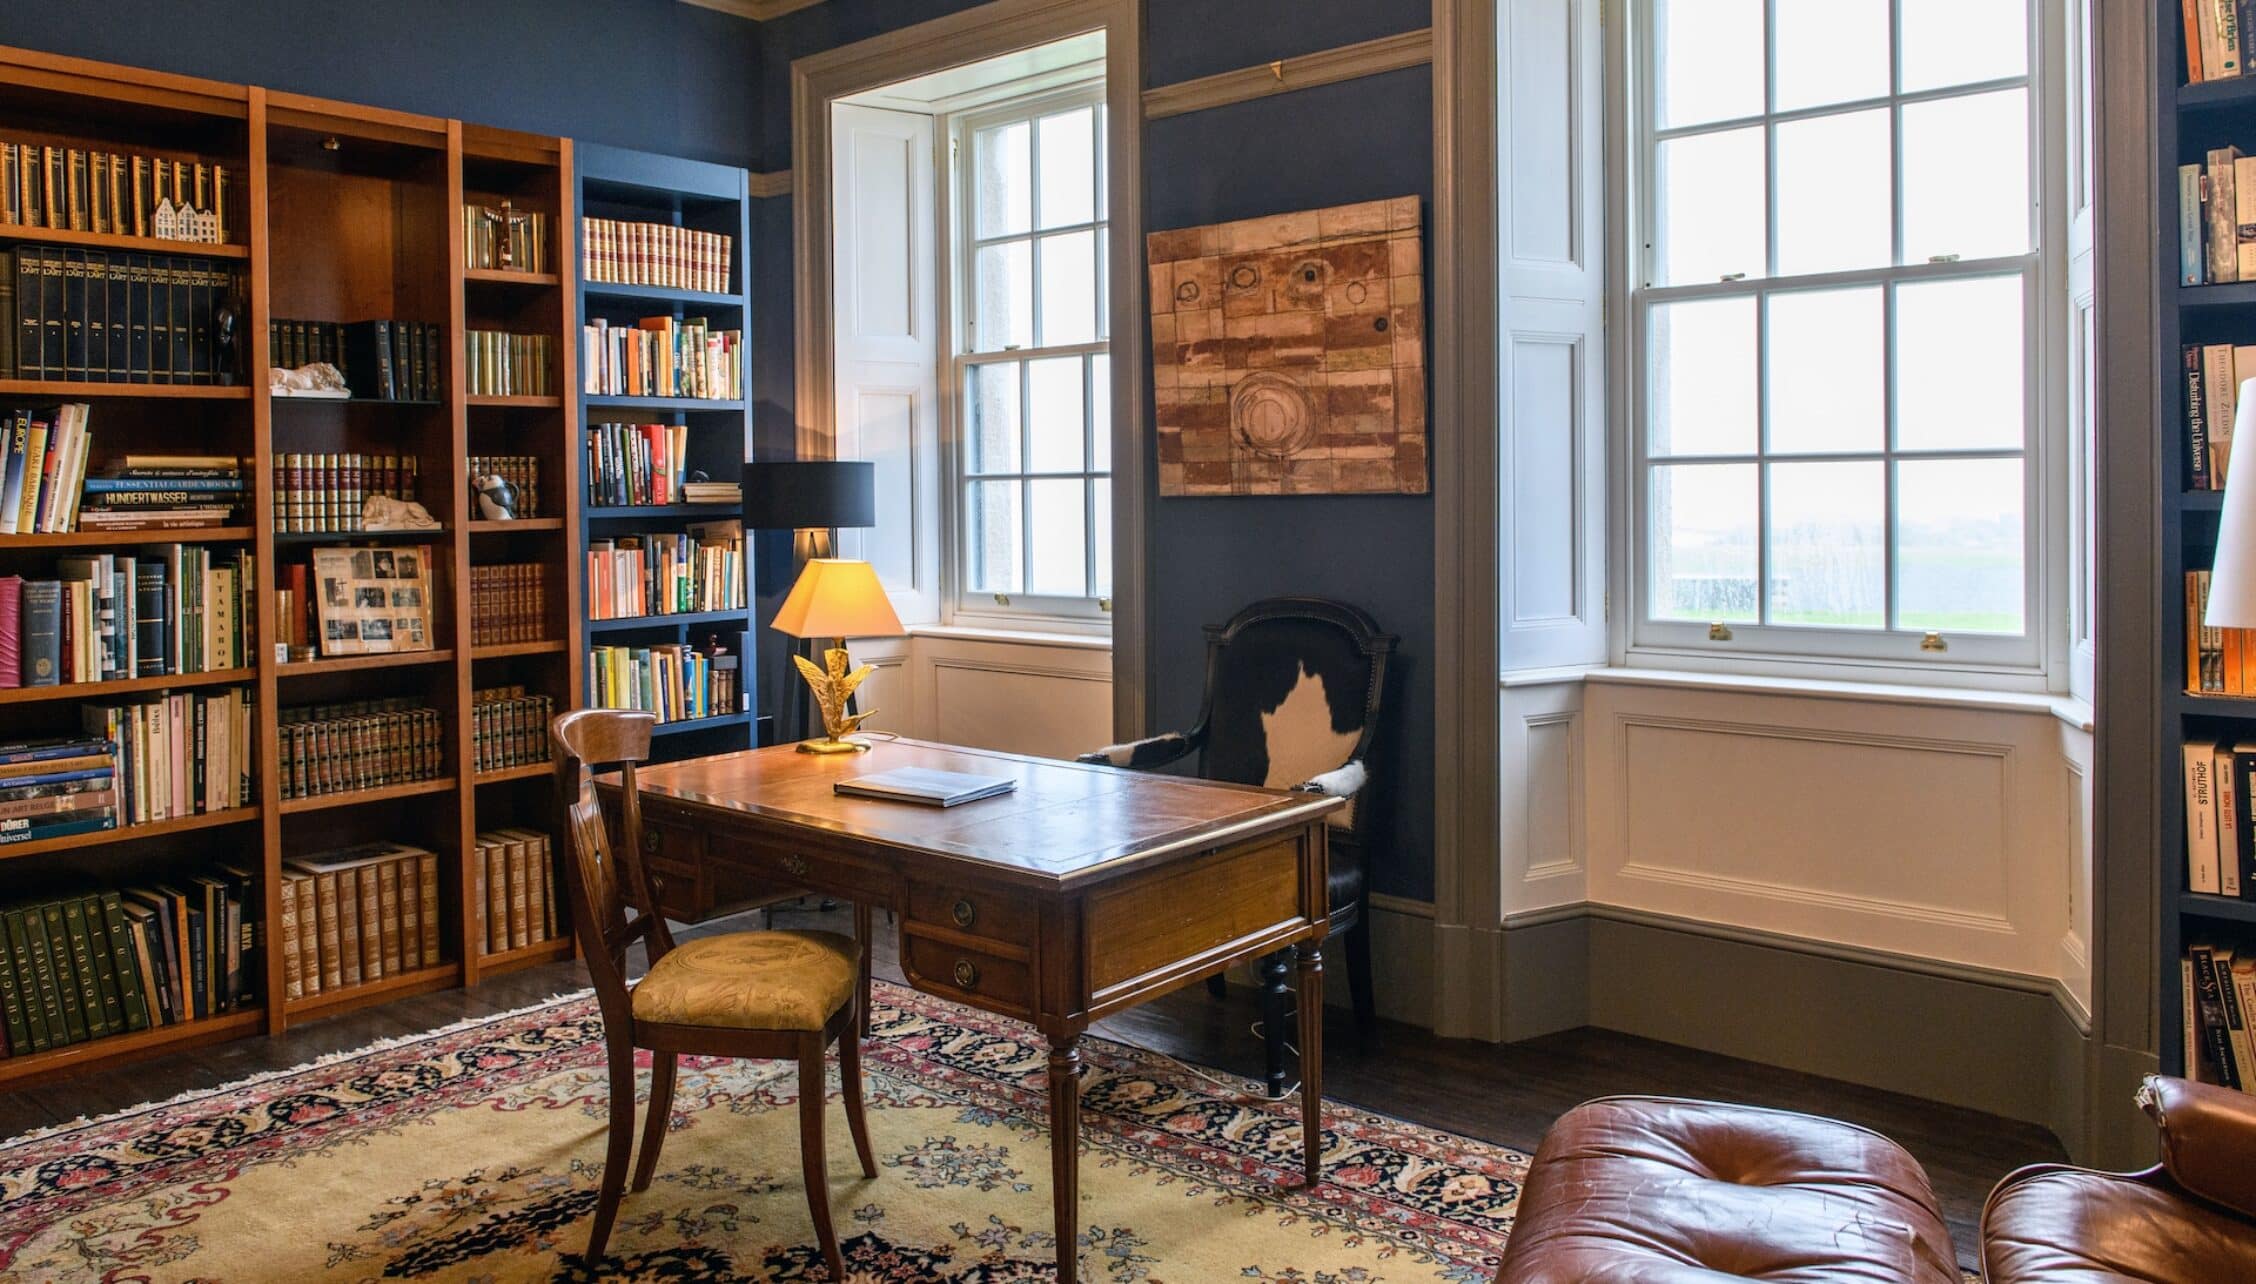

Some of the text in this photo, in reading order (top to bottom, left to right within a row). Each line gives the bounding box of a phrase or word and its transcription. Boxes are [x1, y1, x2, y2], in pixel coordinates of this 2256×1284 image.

[2226, 15, 2236, 51] O'Brien
[14, 417, 27, 454] EUROPE
[25, 473, 38, 514] BAROQUE
[106, 492, 188, 505] HUNDERTWASSER
[217, 572, 225, 656] UTAMARO
[2196, 761, 2208, 805] STRUTHOF
[0, 831, 32, 843] niversel
[241, 923, 253, 951] MAYA
[0, 946, 20, 1025] CHAGALL
[15, 946, 38, 1023] VUILLARD
[33, 939, 57, 1017] LES FAUVES
[73, 933, 96, 1008] ROUAULT
[65, 987, 75, 1012] LES
